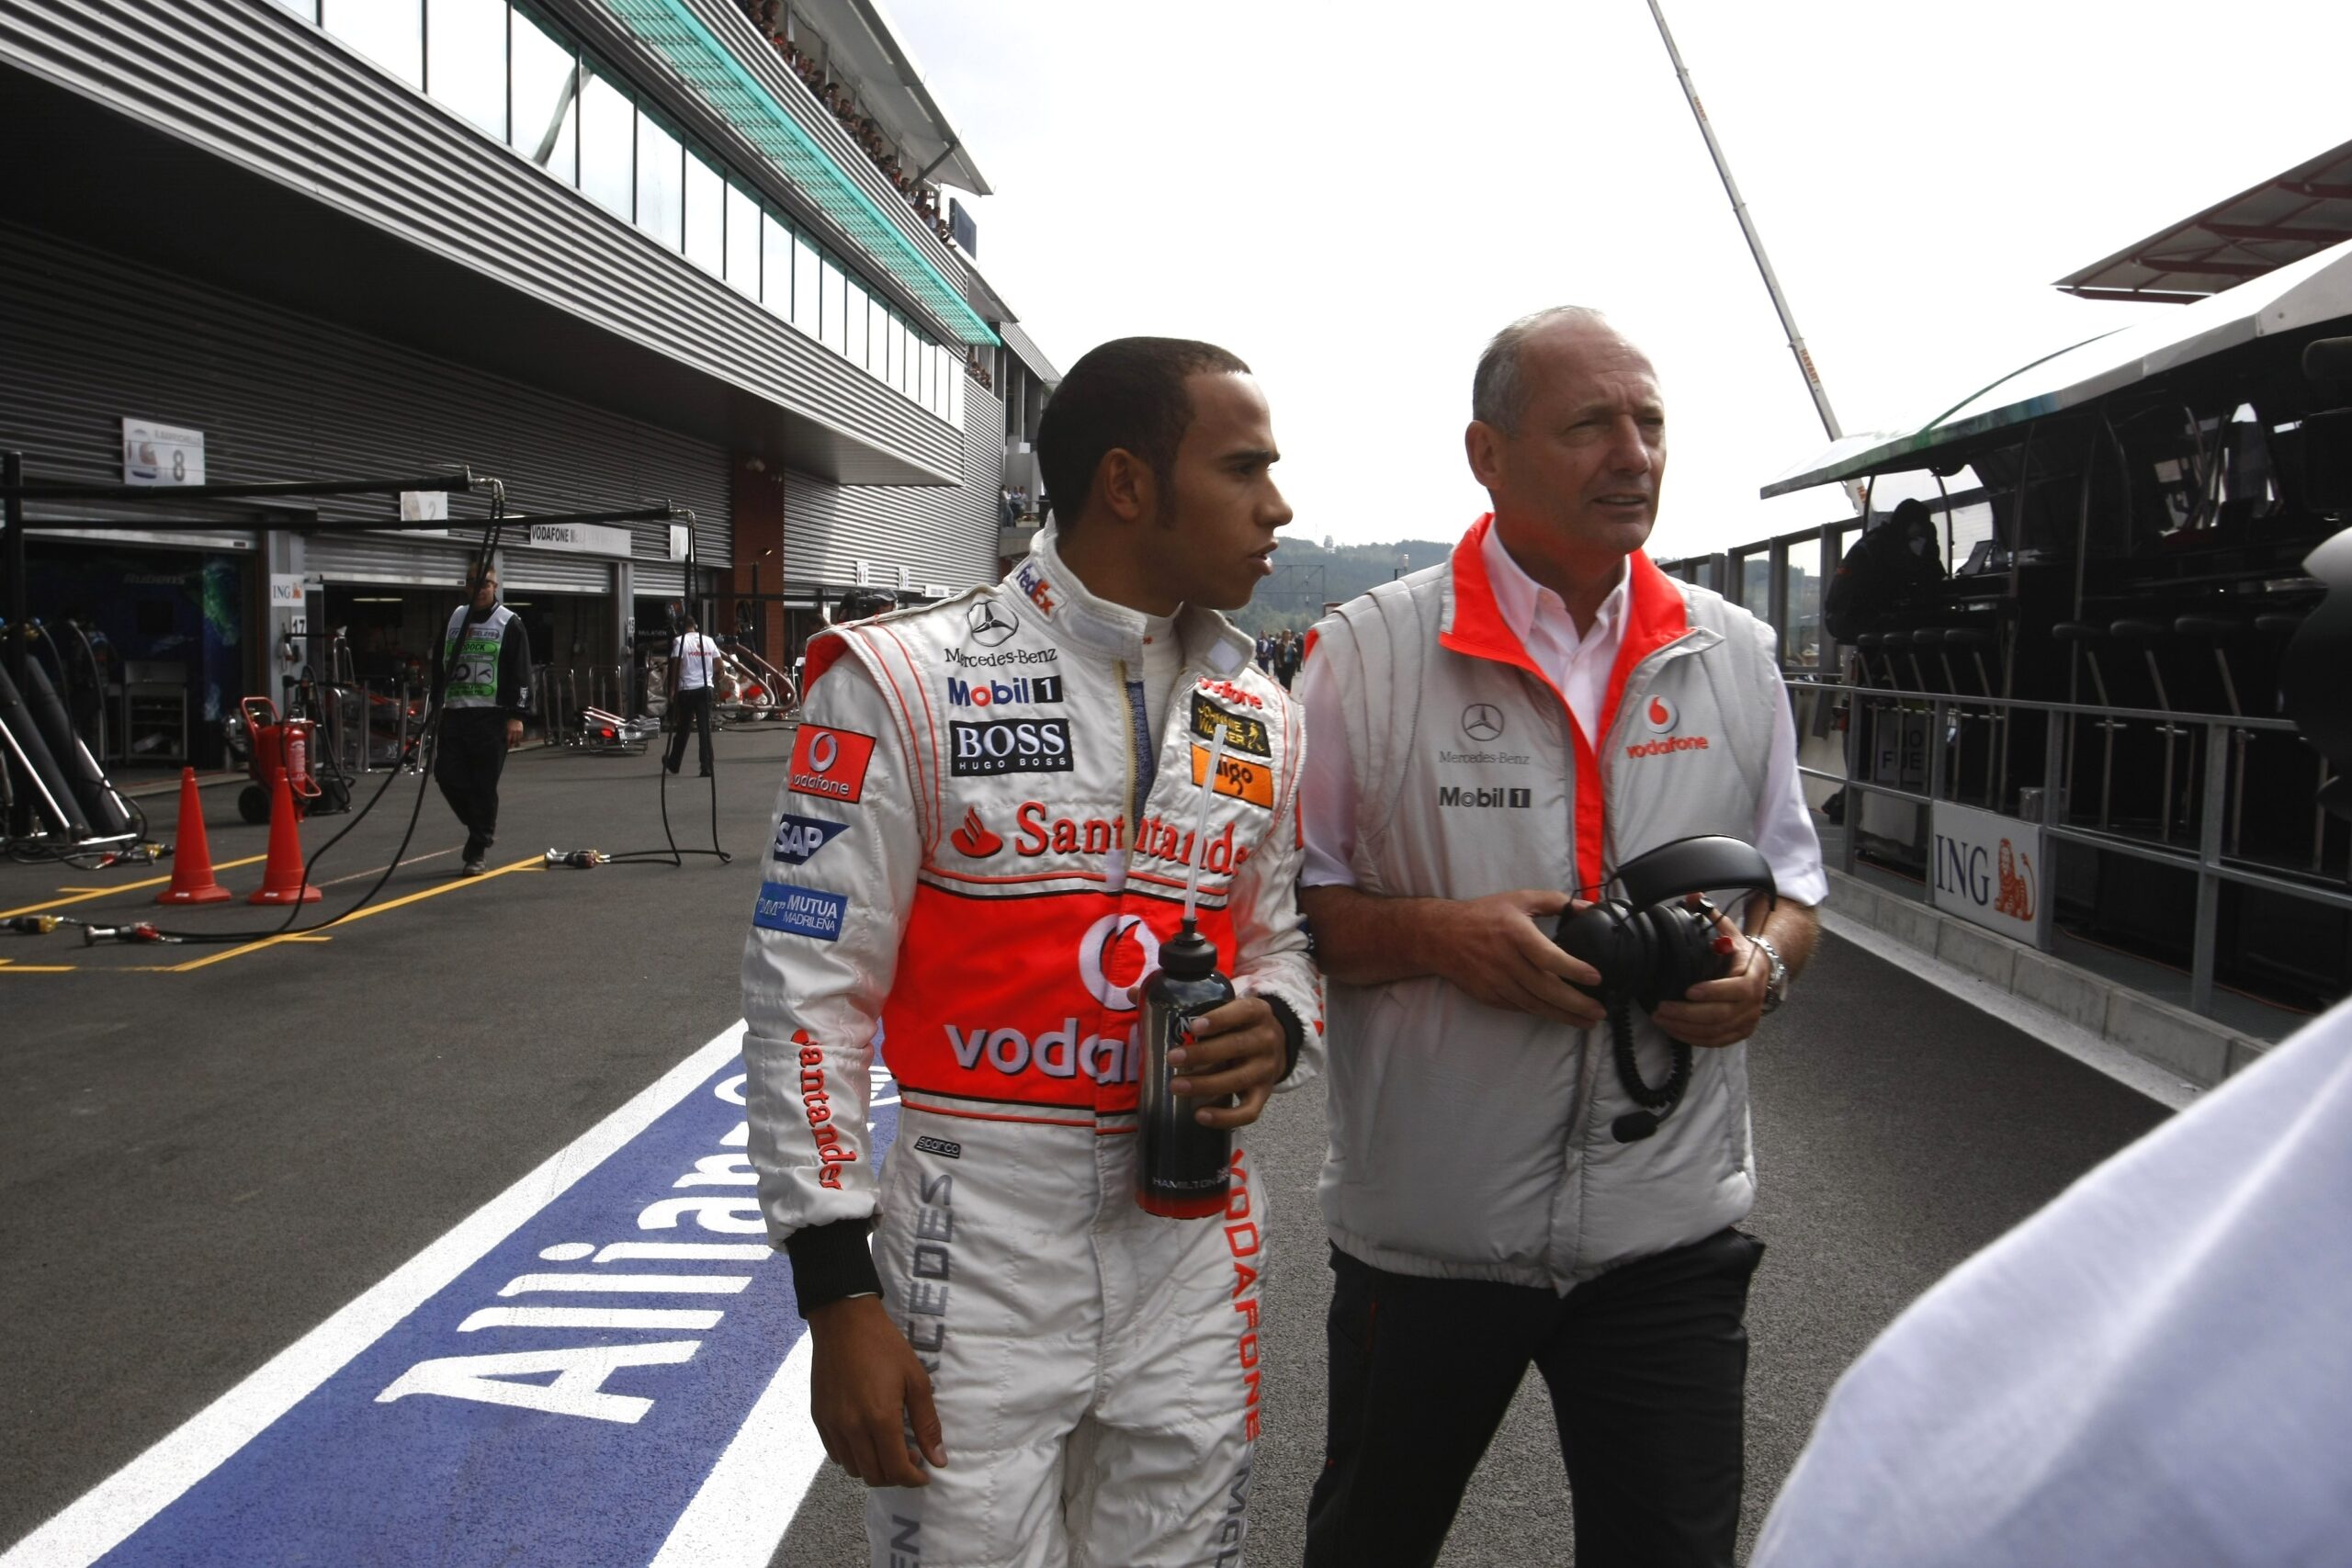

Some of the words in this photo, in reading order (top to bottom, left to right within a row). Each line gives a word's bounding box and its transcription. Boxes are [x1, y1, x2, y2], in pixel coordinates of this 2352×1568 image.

[173, 449, 185, 482] 8
[531, 525, 569, 542] VODAFONE
[273, 585, 291, 599] ING
[1016, 562, 1056, 617] FedEx
[292, 619, 305, 634] 17
[944, 648, 1057, 667] Mercedes-Benz
[947, 677, 1030, 706] Mobil
[956, 724, 1065, 758] BOSS
[1625, 735, 1709, 759] vodafone
[959, 760, 1005, 770] HUGO
[1019, 757, 1066, 766] BOSS
[1439, 750, 1530, 765] Mercedes-Benz
[793, 773, 850, 795] odafone
[1439, 786, 1504, 808] Mobil
[775, 821, 823, 857] SAP
[1936, 834, 1990, 906] ING
[787, 894, 837, 919] MUTUA
[799, 1046, 857, 1190] antander
[919, 1136, 959, 1154] sparco
